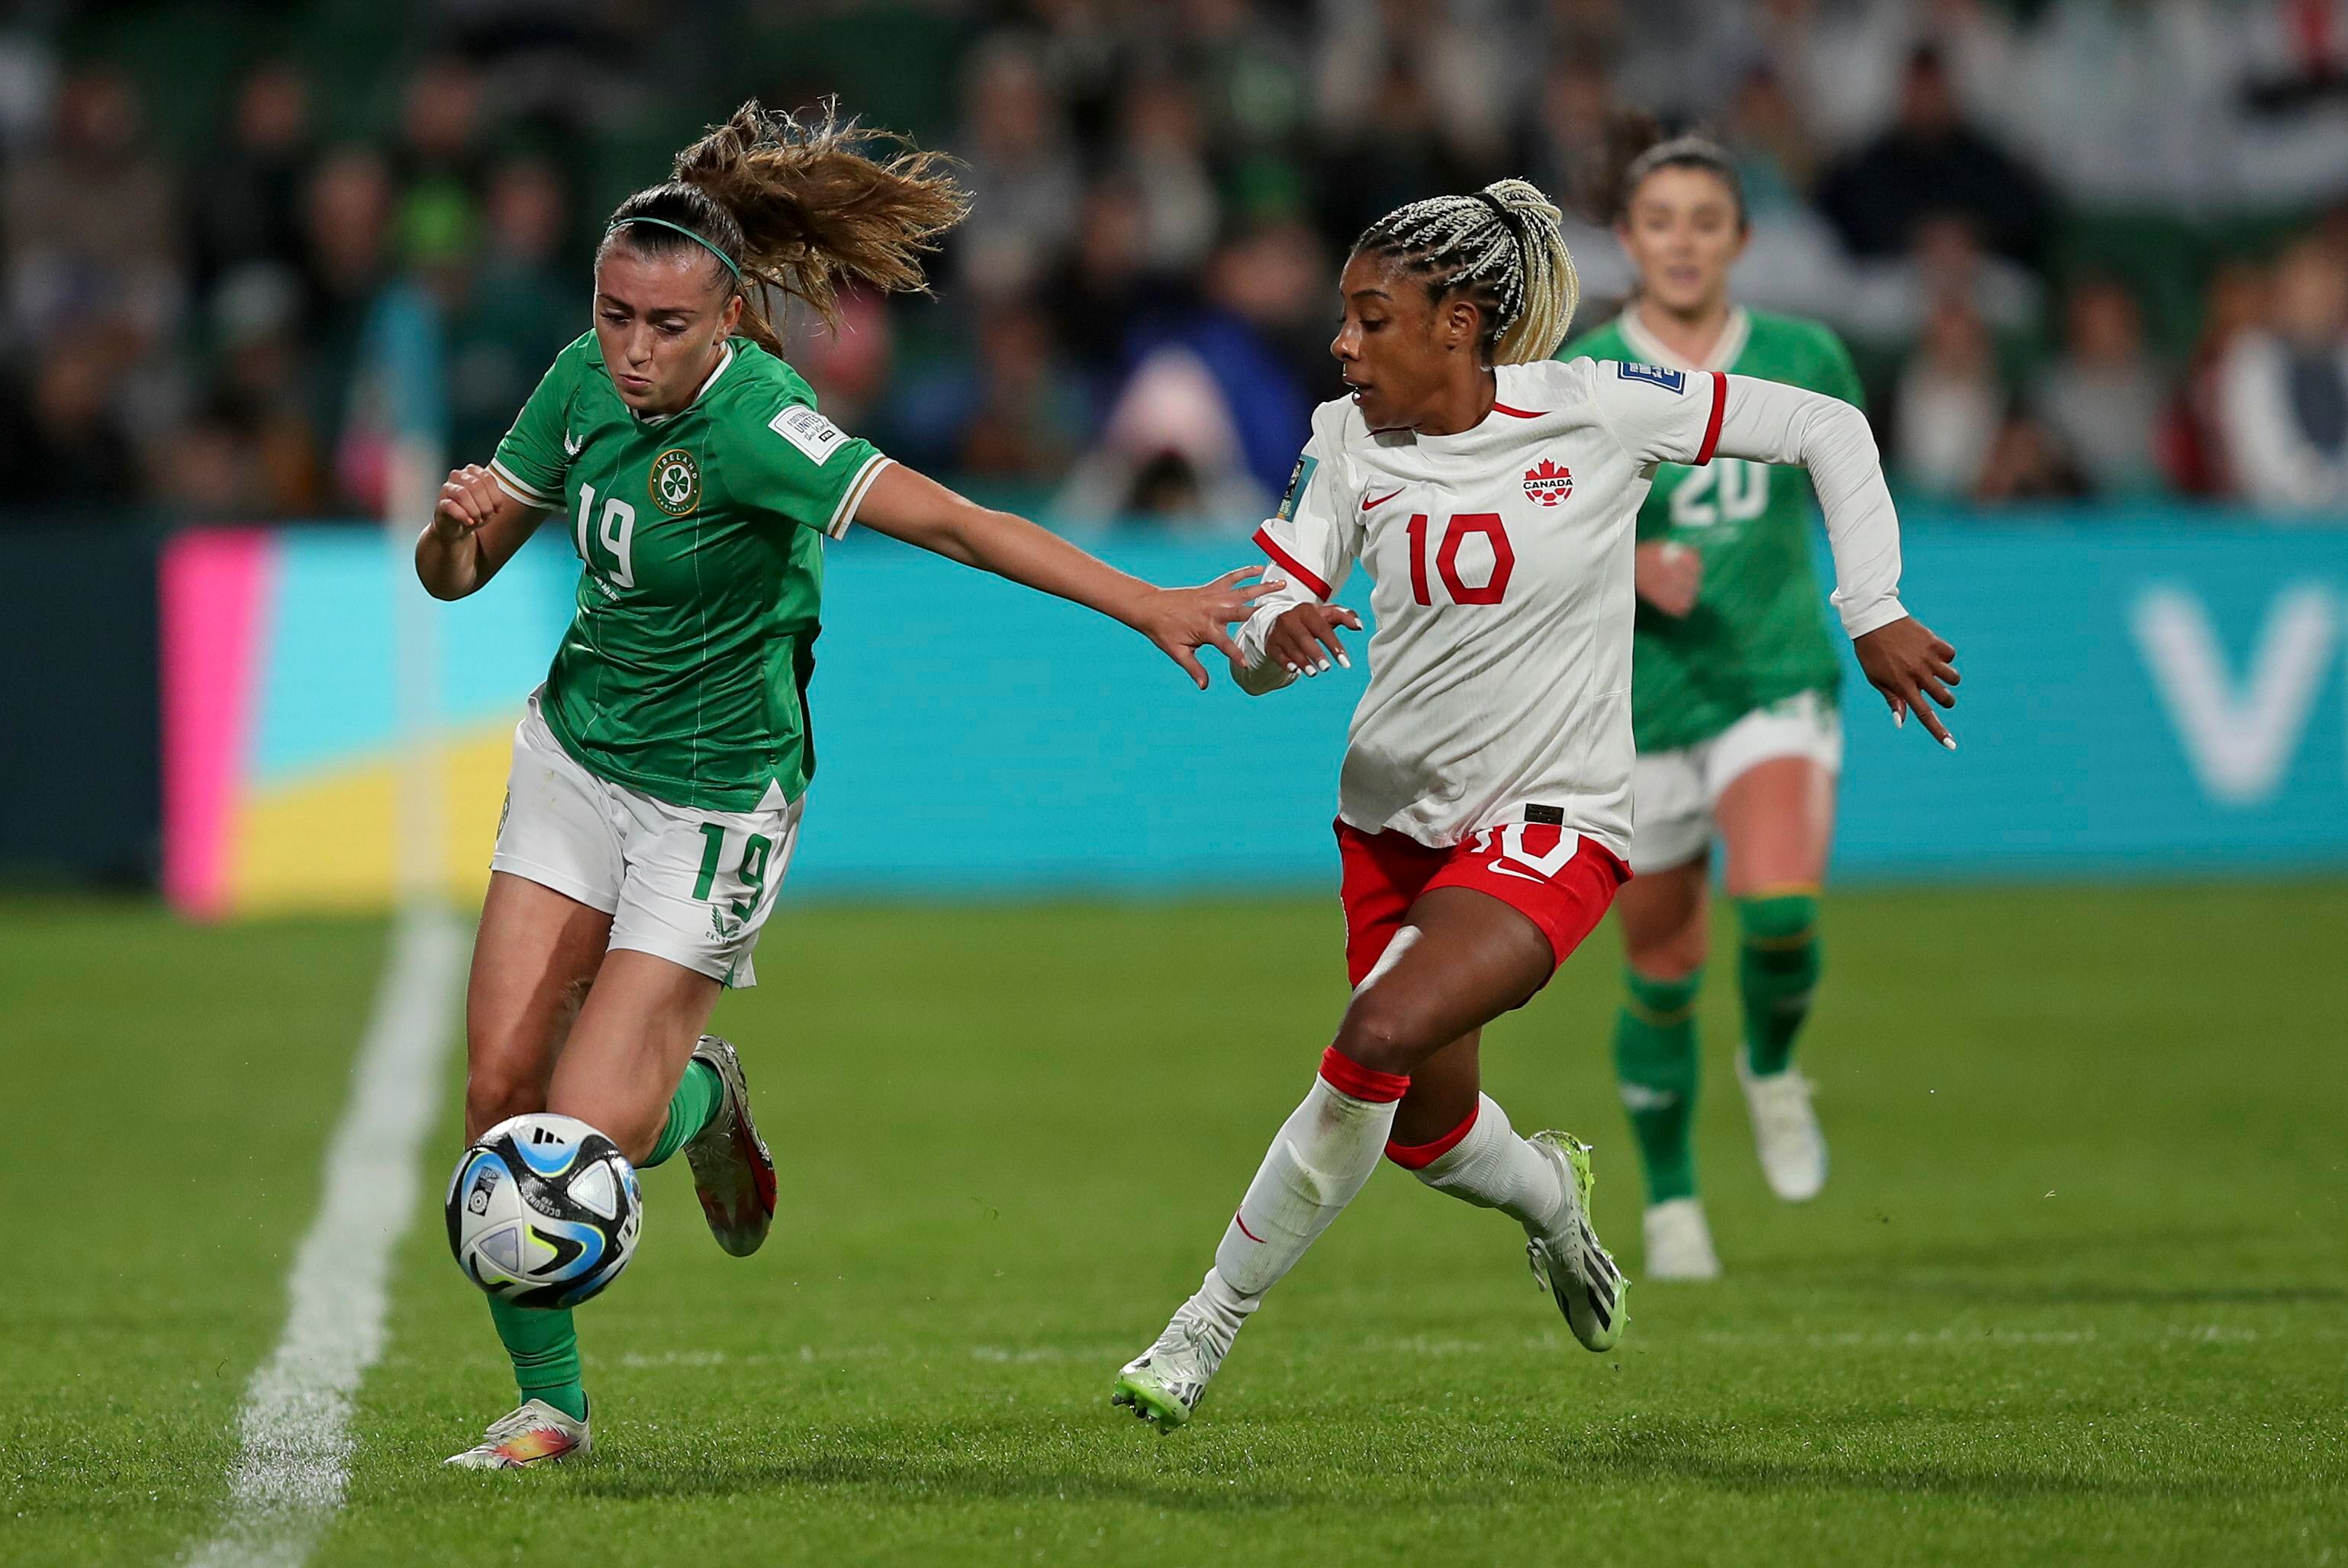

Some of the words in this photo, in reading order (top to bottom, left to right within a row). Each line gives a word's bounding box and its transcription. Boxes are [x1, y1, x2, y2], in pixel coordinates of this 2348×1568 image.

[794, 414, 820, 433] UNITES
[657, 453, 697, 479] IRELAND
[1522, 478, 1573, 489] CANADA
[1670, 458, 1770, 525] 20
[578, 482, 635, 588] 19
[1406, 513, 1515, 605] 10
[691, 821, 772, 922] 19
